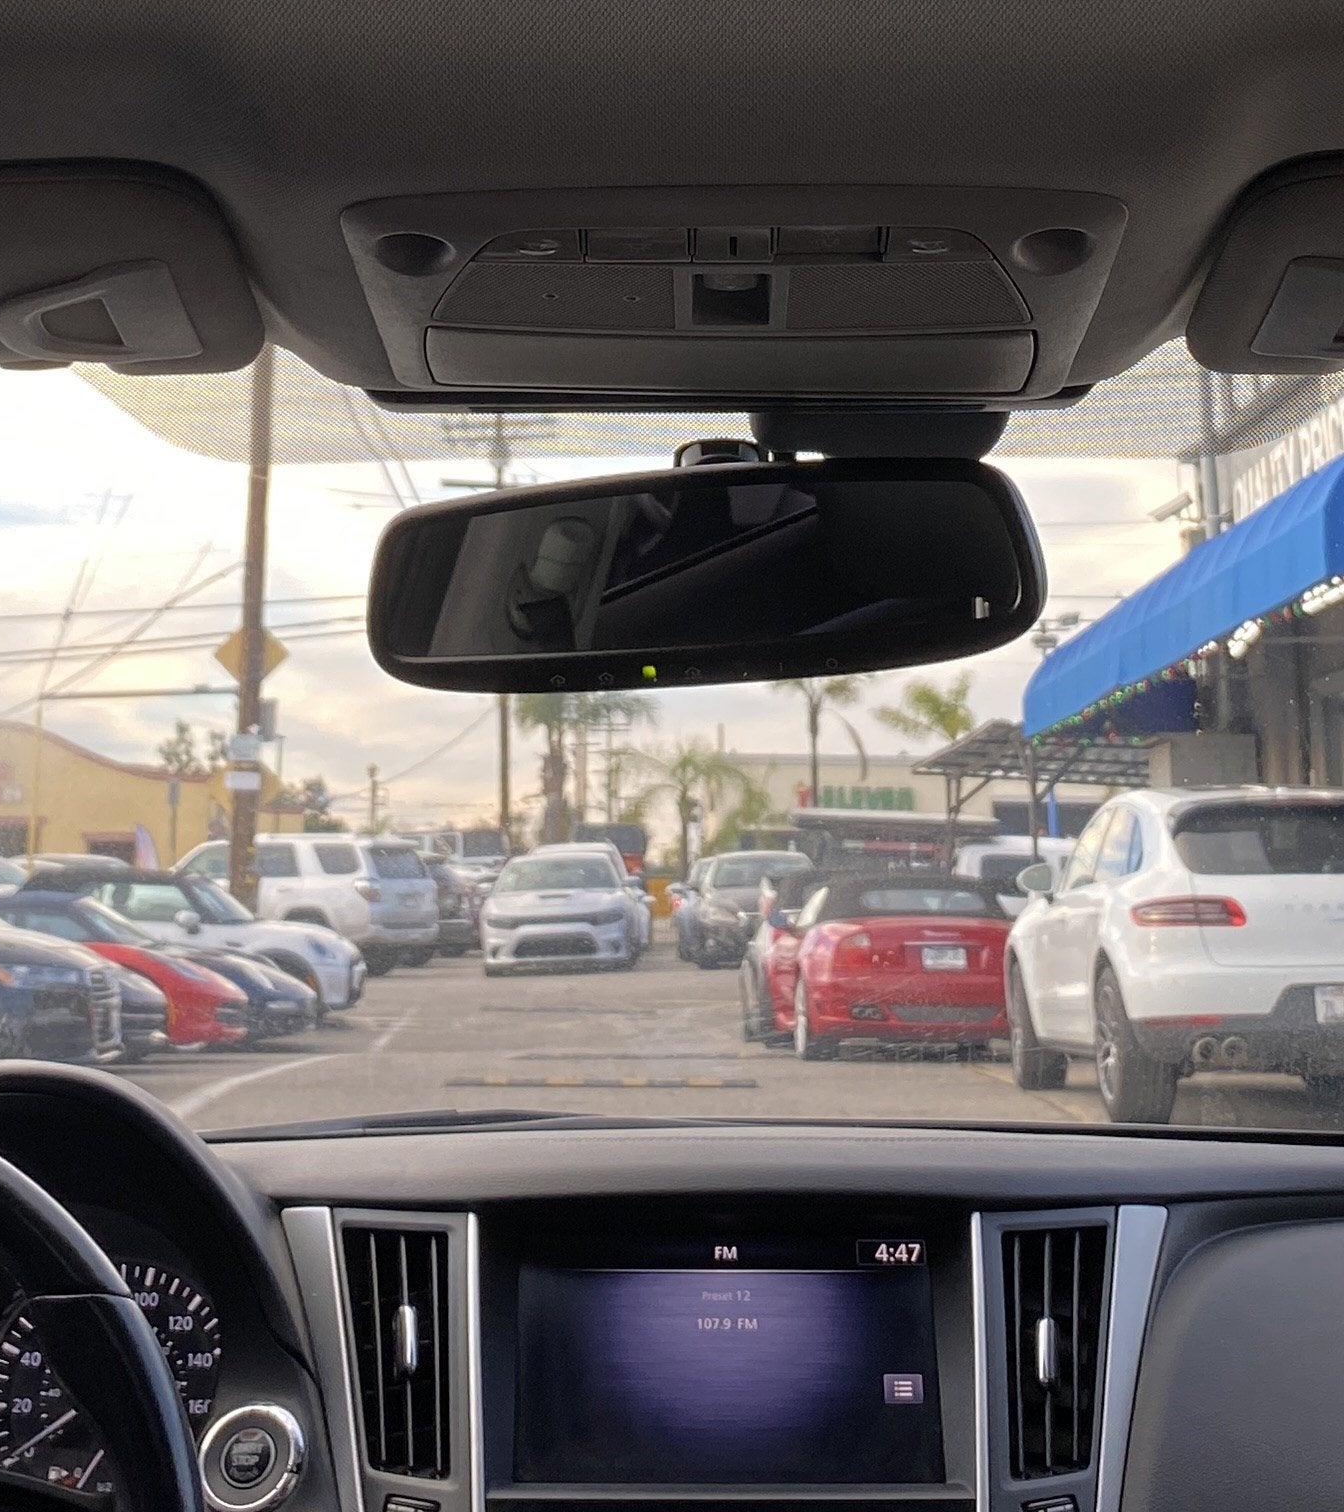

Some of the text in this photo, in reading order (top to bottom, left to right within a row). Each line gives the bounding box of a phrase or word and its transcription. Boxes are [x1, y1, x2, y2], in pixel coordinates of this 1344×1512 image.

[1233, 432, 1300, 525] QUALITY
[714, 1245, 739, 1261] FM
[875, 1243, 922, 1263] 4:47
[701, 1290, 752, 1301] Preset 12
[168, 1316, 194, 1331] 120
[697, 1318, 758, 1330] 107.9 FM
[19, 1351, 42, 1368] 40
[187, 1352, 213, 1368] 140
[11, 1398, 33, 1414] 20
[231, 1454, 260, 1467] STOP
